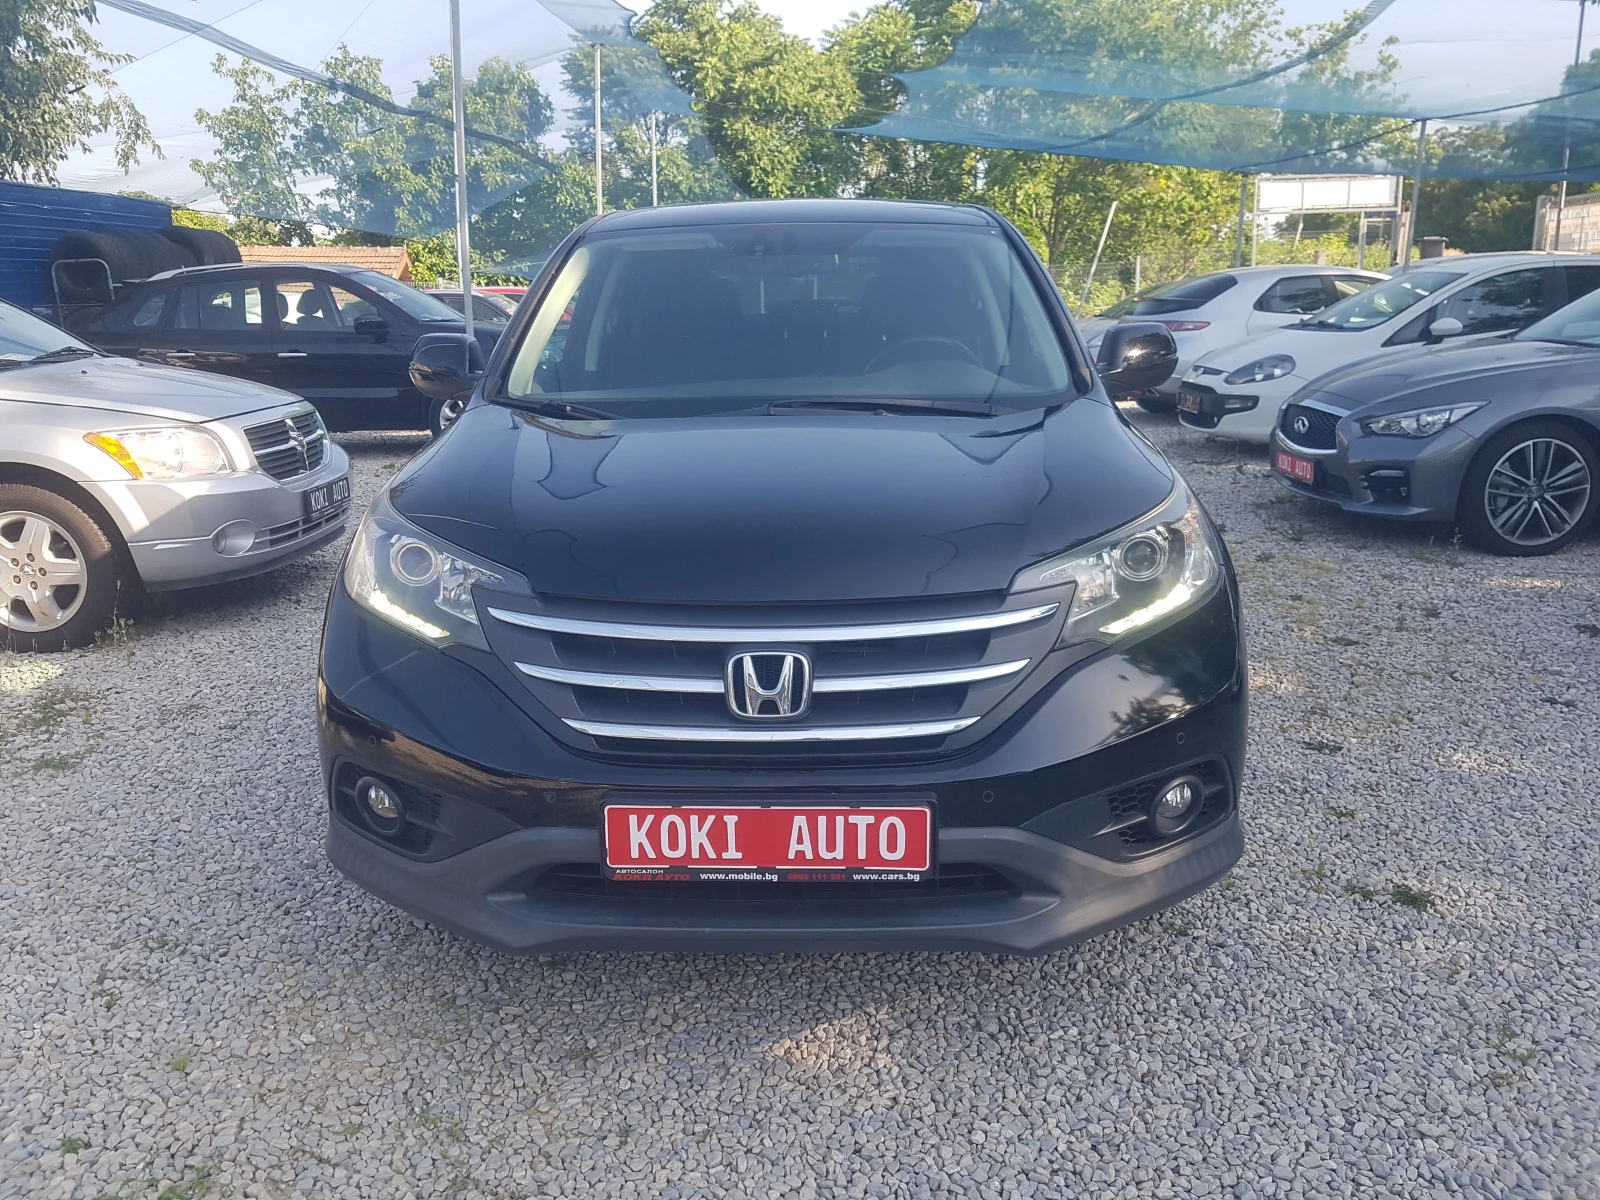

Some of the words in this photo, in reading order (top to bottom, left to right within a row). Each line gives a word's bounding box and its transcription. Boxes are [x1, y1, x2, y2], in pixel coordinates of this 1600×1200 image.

[1295, 459, 1311, 479] AUTO
[310, 487, 329, 511] KOKI
[332, 479, 349, 502] AUTO
[629, 814, 743, 860] KOKI
[787, 815, 906, 861] AUTO
[699, 872, 778, 882] www.mobile.bg
[811, 873, 828, 881] 111
[852, 872, 920, 882] www.cars.bg
